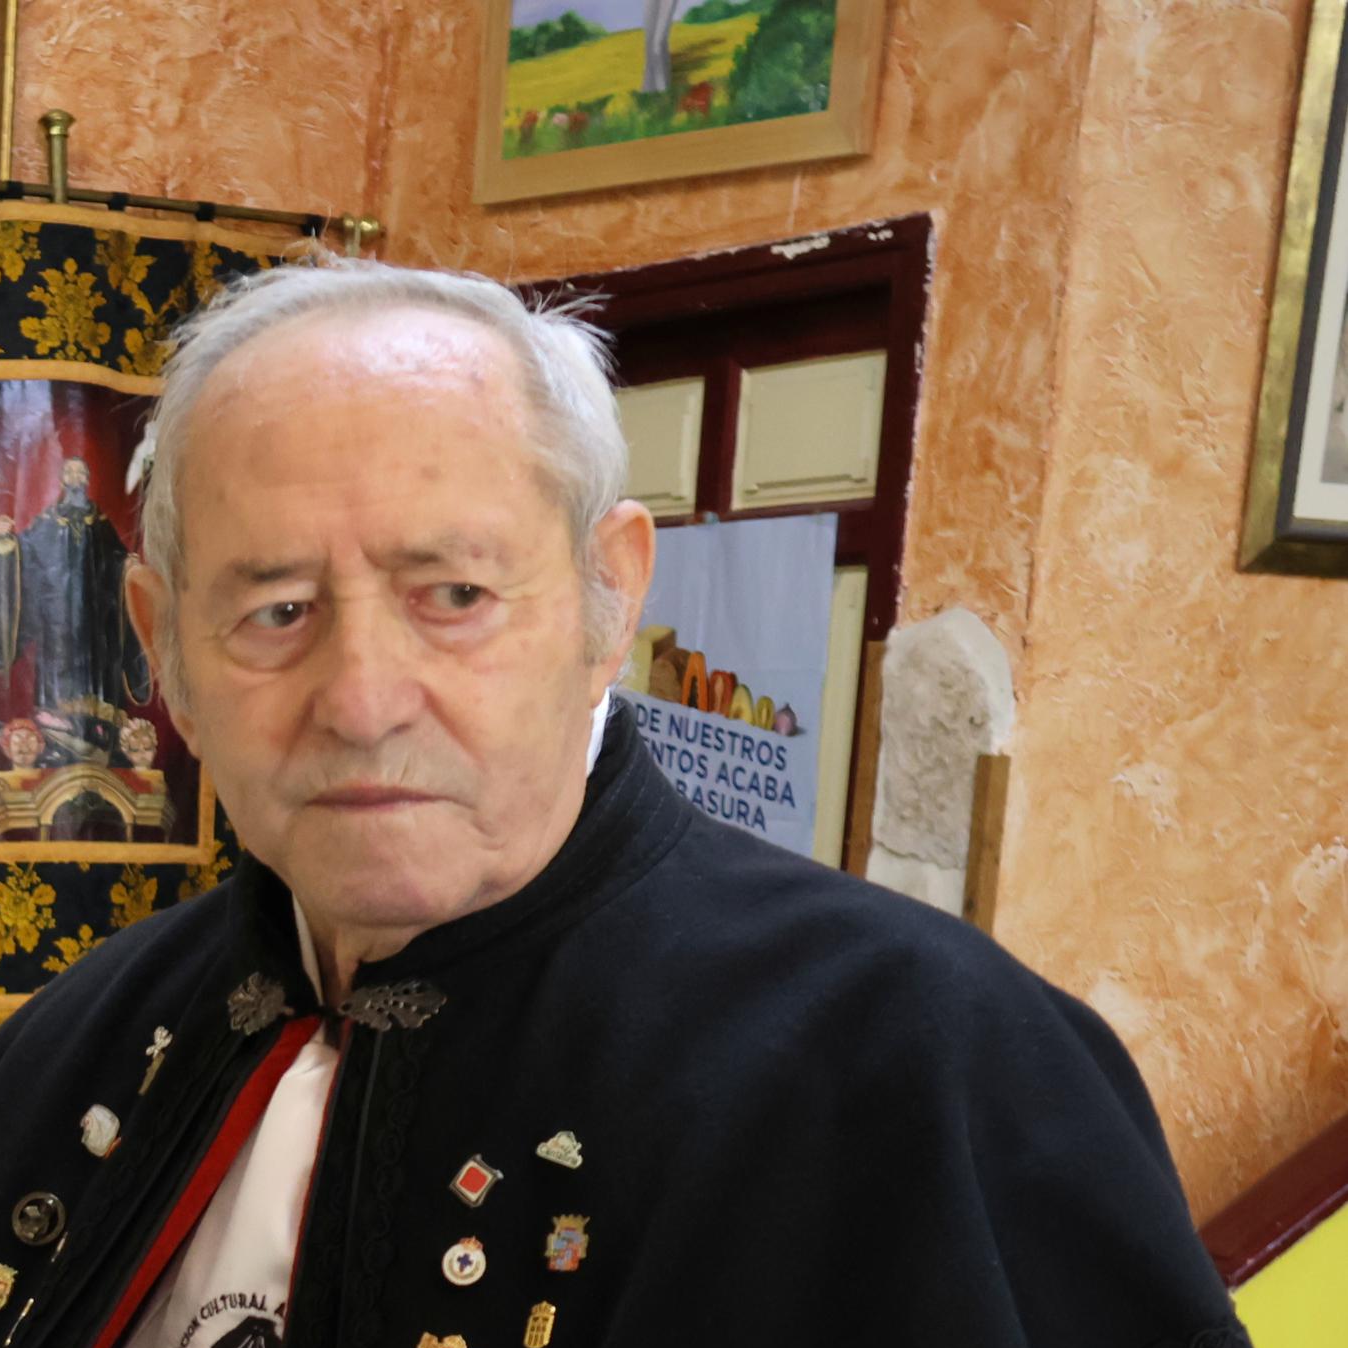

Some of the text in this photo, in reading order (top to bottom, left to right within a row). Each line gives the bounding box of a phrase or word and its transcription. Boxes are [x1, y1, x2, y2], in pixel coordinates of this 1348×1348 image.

[635, 703, 788, 772] DE NUESTROS
[643, 736, 797, 809] NTOS ACABA
[200, 1292, 267, 1320] CULTURAL
